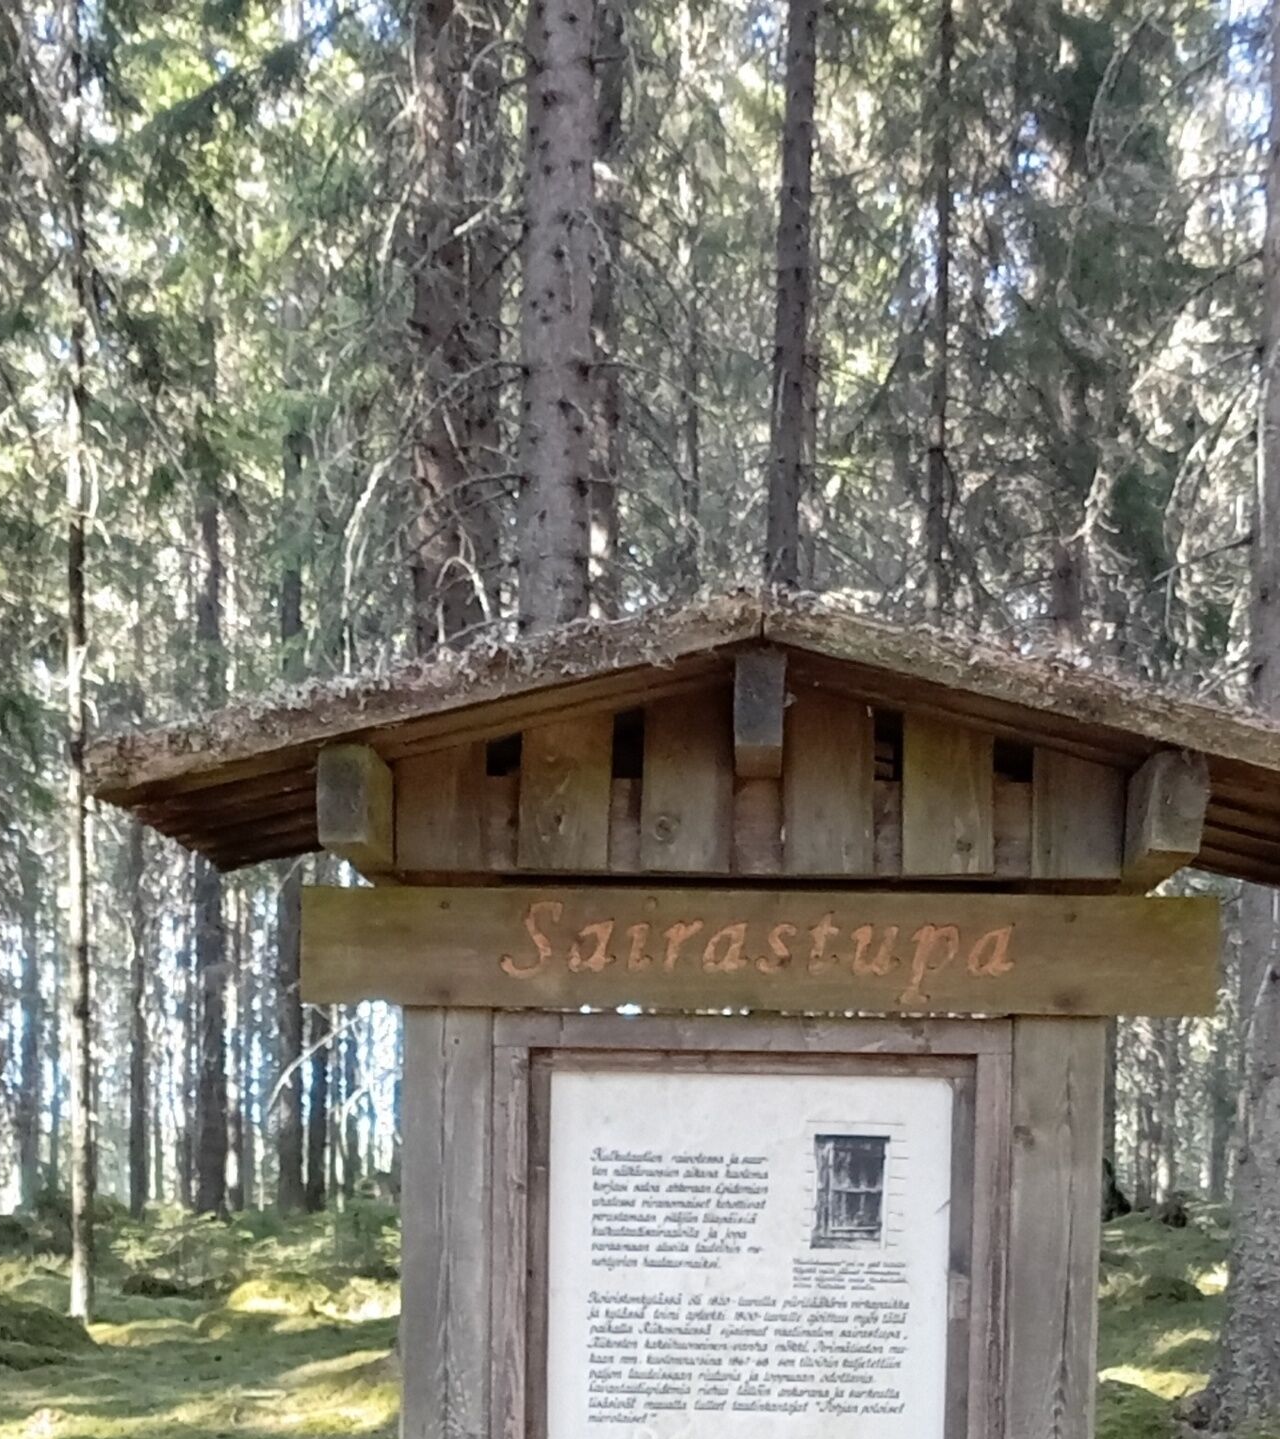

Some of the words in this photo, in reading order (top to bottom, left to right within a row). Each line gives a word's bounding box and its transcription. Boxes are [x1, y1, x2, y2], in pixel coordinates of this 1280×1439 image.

[500, 898, 1016, 1004] Sairastupa
[726, 1152, 738, 1167] ja
[703, 1227, 718, 1242] ja
[720, 1227, 747, 1242] jopa
[688, 1294, 702, 1306] oli
[586, 1306, 599, 1321] ja
[604, 1306, 646, 1322] kylässä
[853, 1311, 880, 1326] myös
[588, 1352, 614, 1364] kaan
[777, 1359, 796, 1367] sen
[747, 1370, 759, 1385] ja
[830, 1386, 844, 1401] ja
